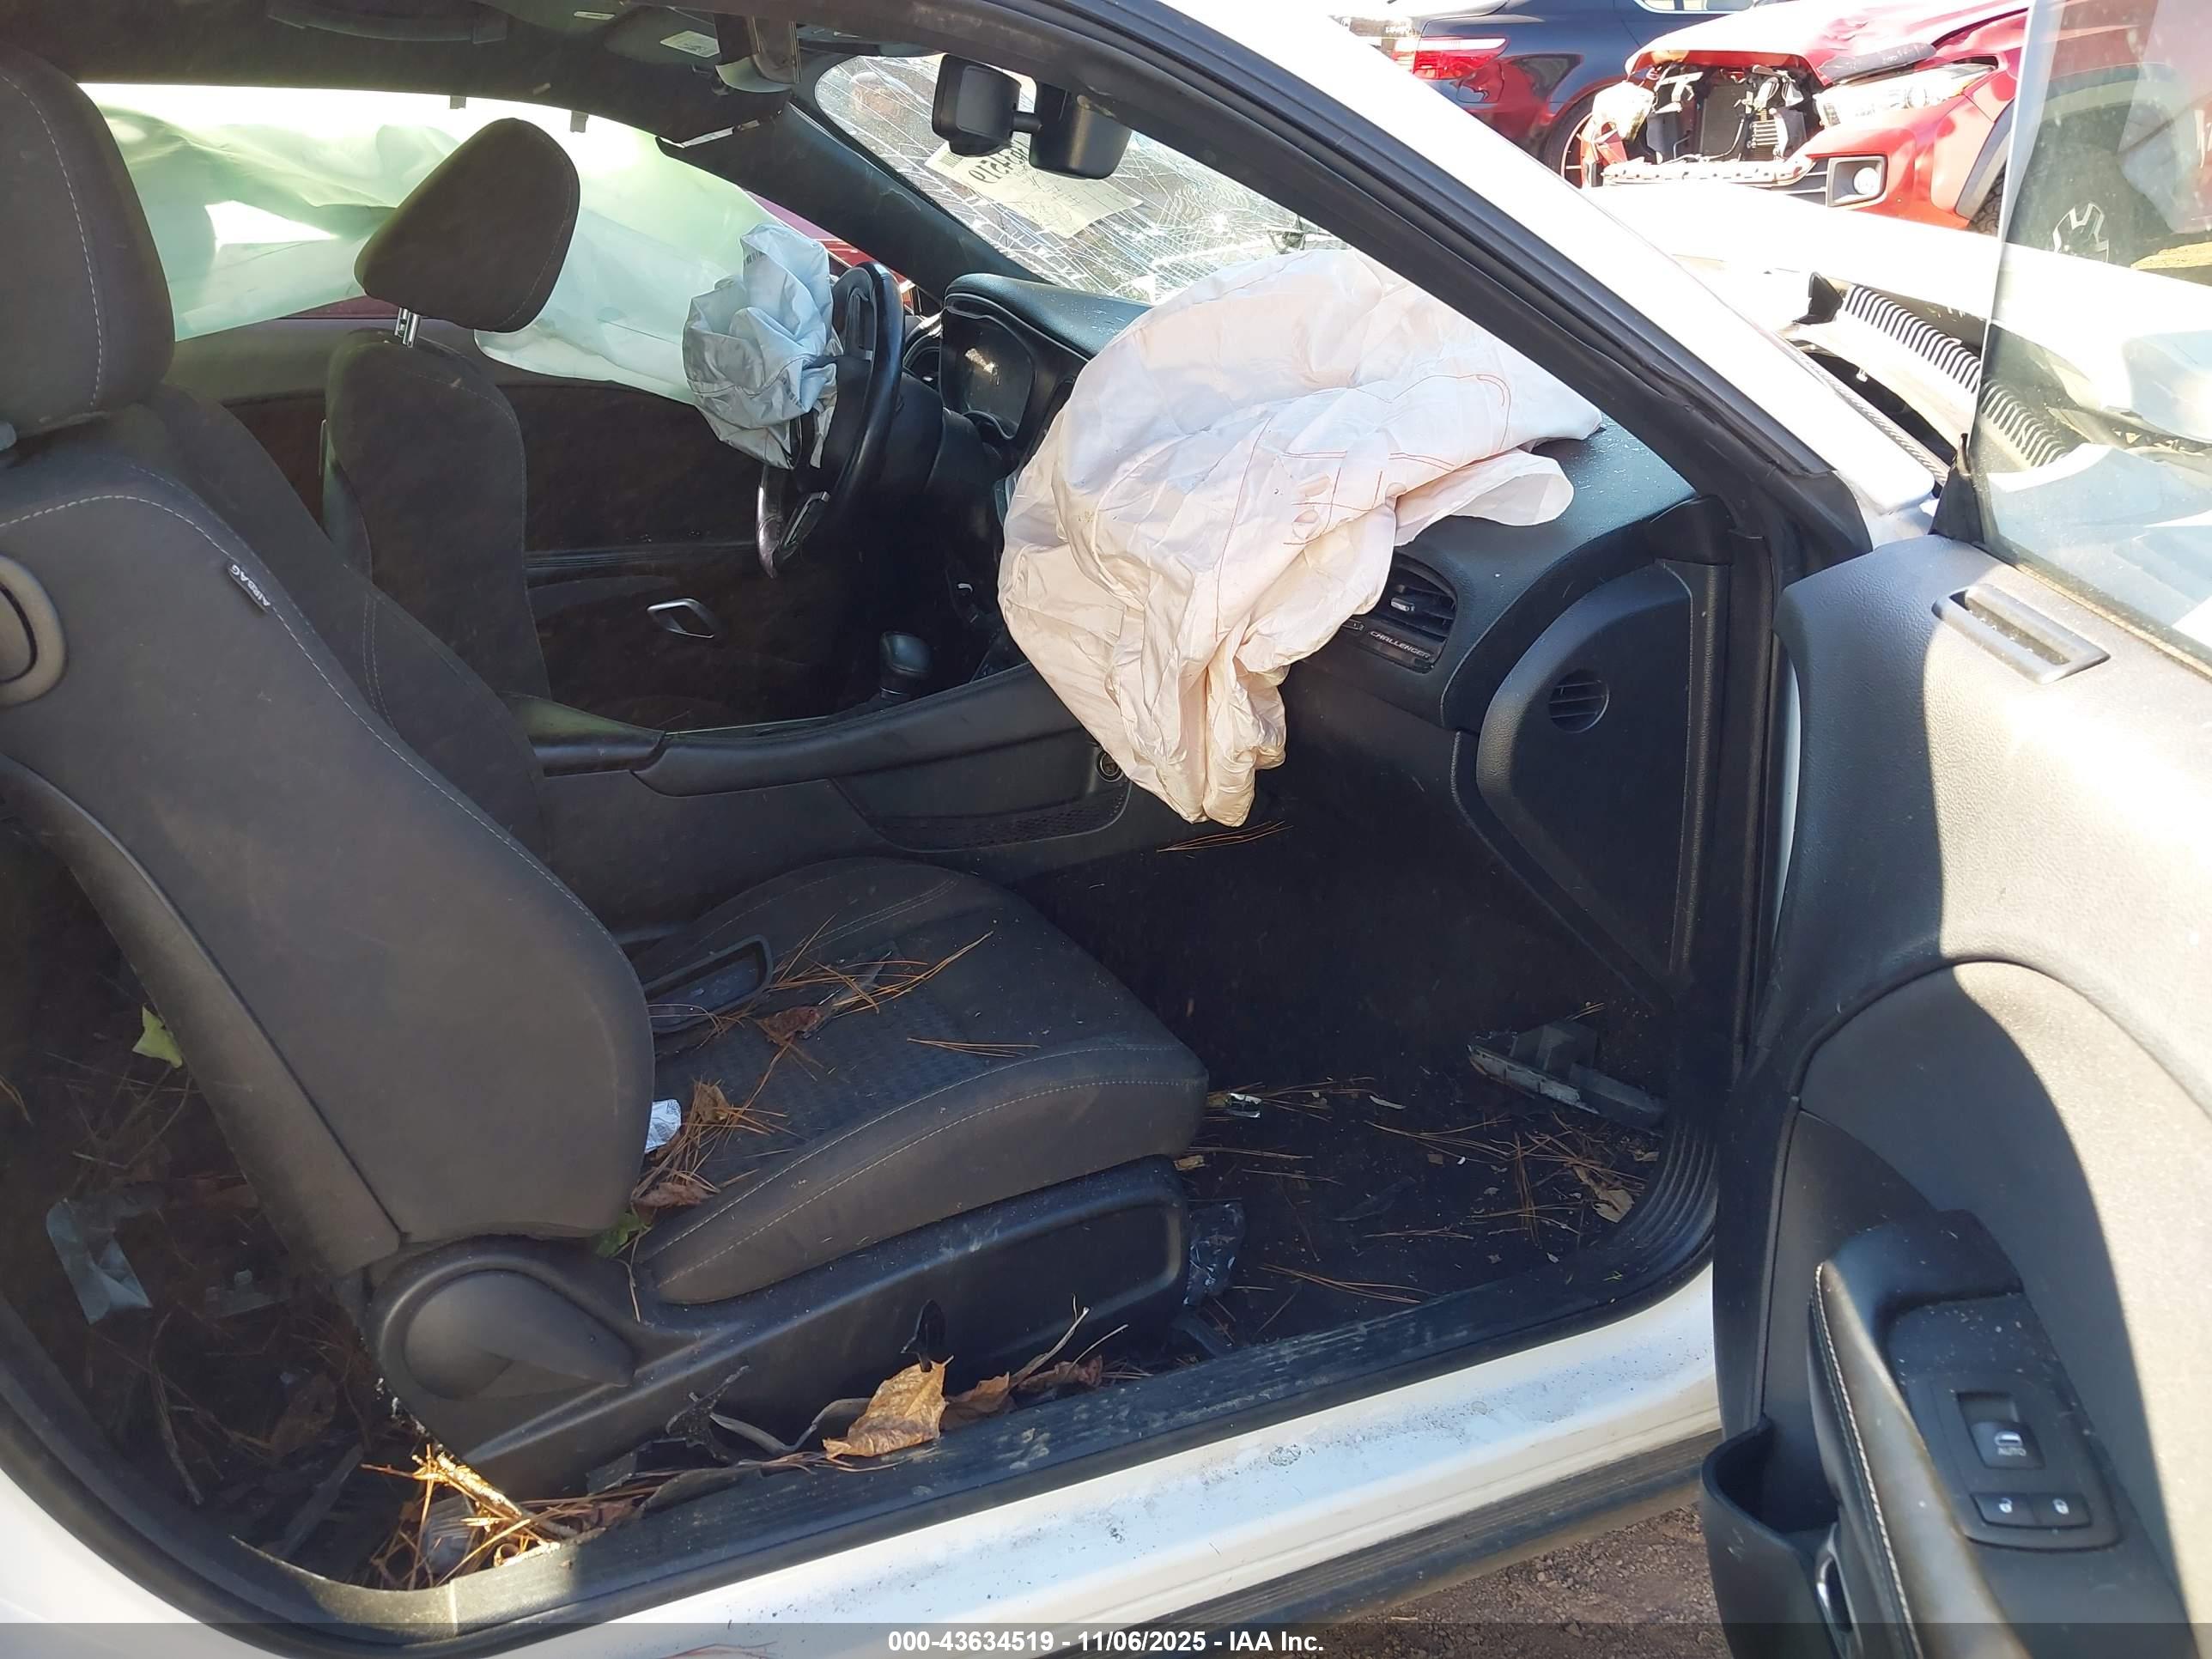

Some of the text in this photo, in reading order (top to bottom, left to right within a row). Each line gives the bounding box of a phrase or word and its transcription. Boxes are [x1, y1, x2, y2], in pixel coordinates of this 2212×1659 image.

[229, 564, 271, 606] AIRBAG
[1370, 631, 1431, 659] CHALLENGER
[1997, 1447, 2027, 1457] AUTO
